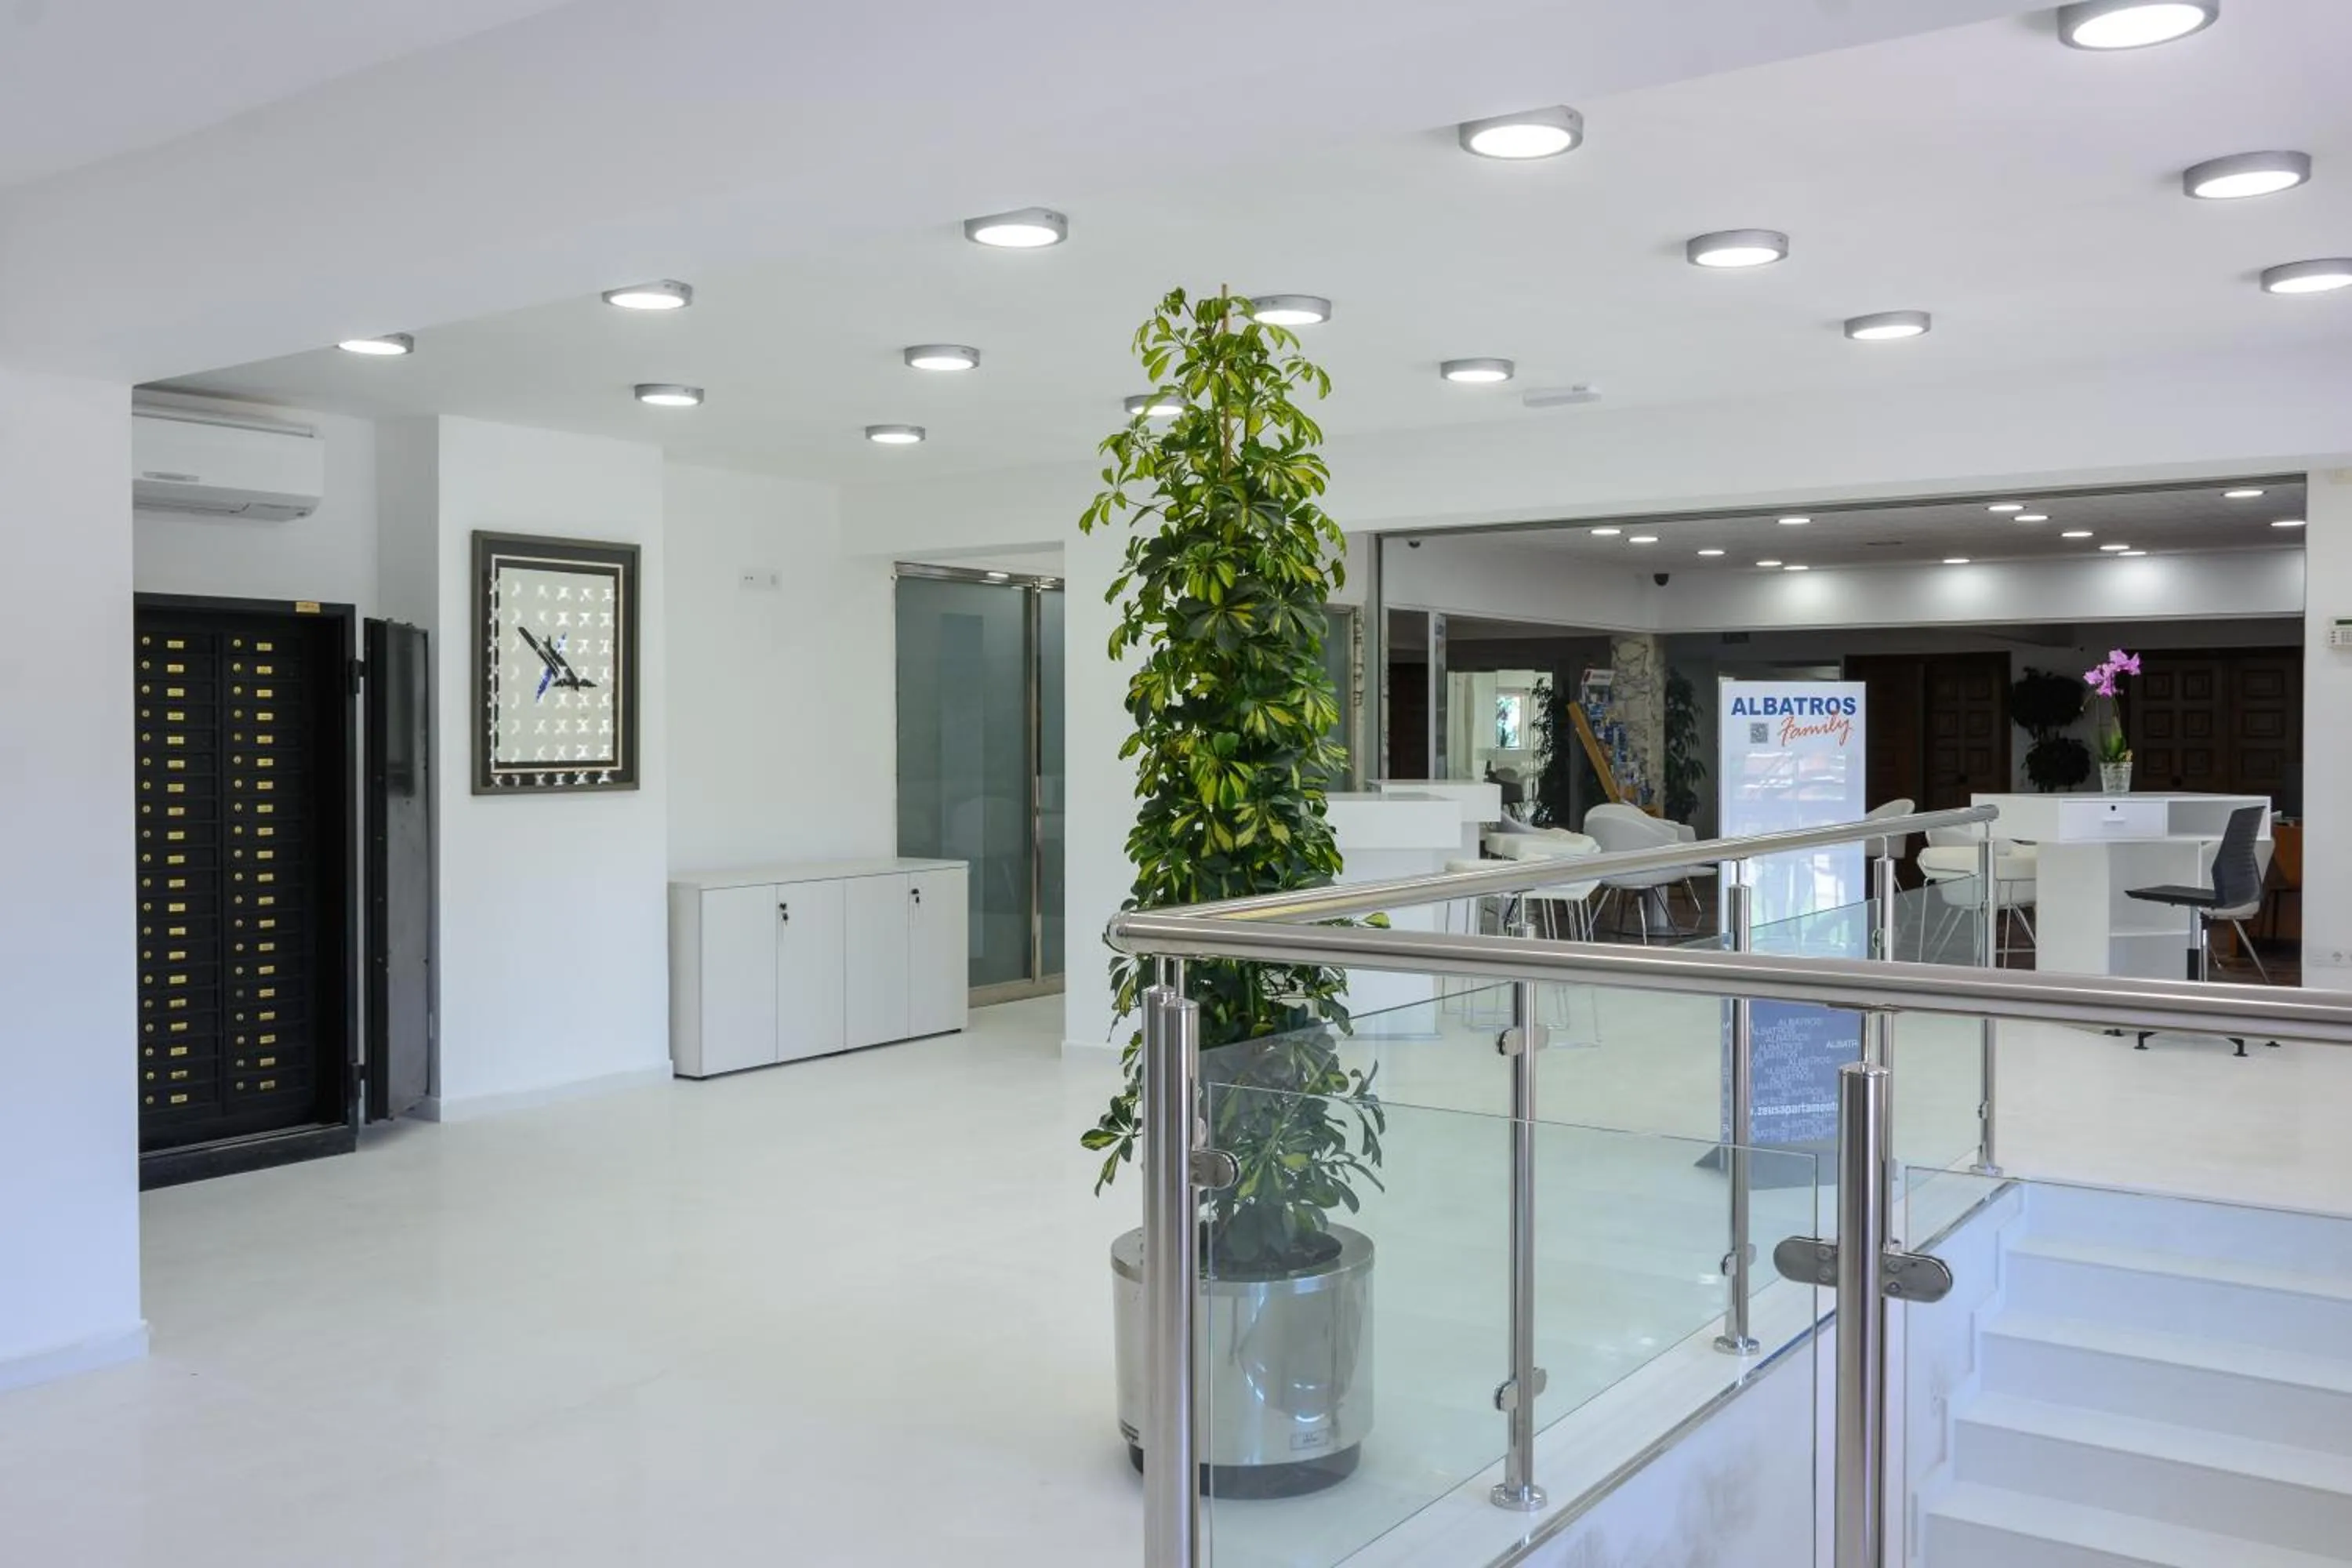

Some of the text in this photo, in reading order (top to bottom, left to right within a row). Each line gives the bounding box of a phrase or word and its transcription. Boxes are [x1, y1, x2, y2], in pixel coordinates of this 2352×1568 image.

[1731, 696, 1857, 716] ALBATROS
[1777, 711, 1853, 746] Family
[1826, 1039, 1858, 1049] ALBATR
